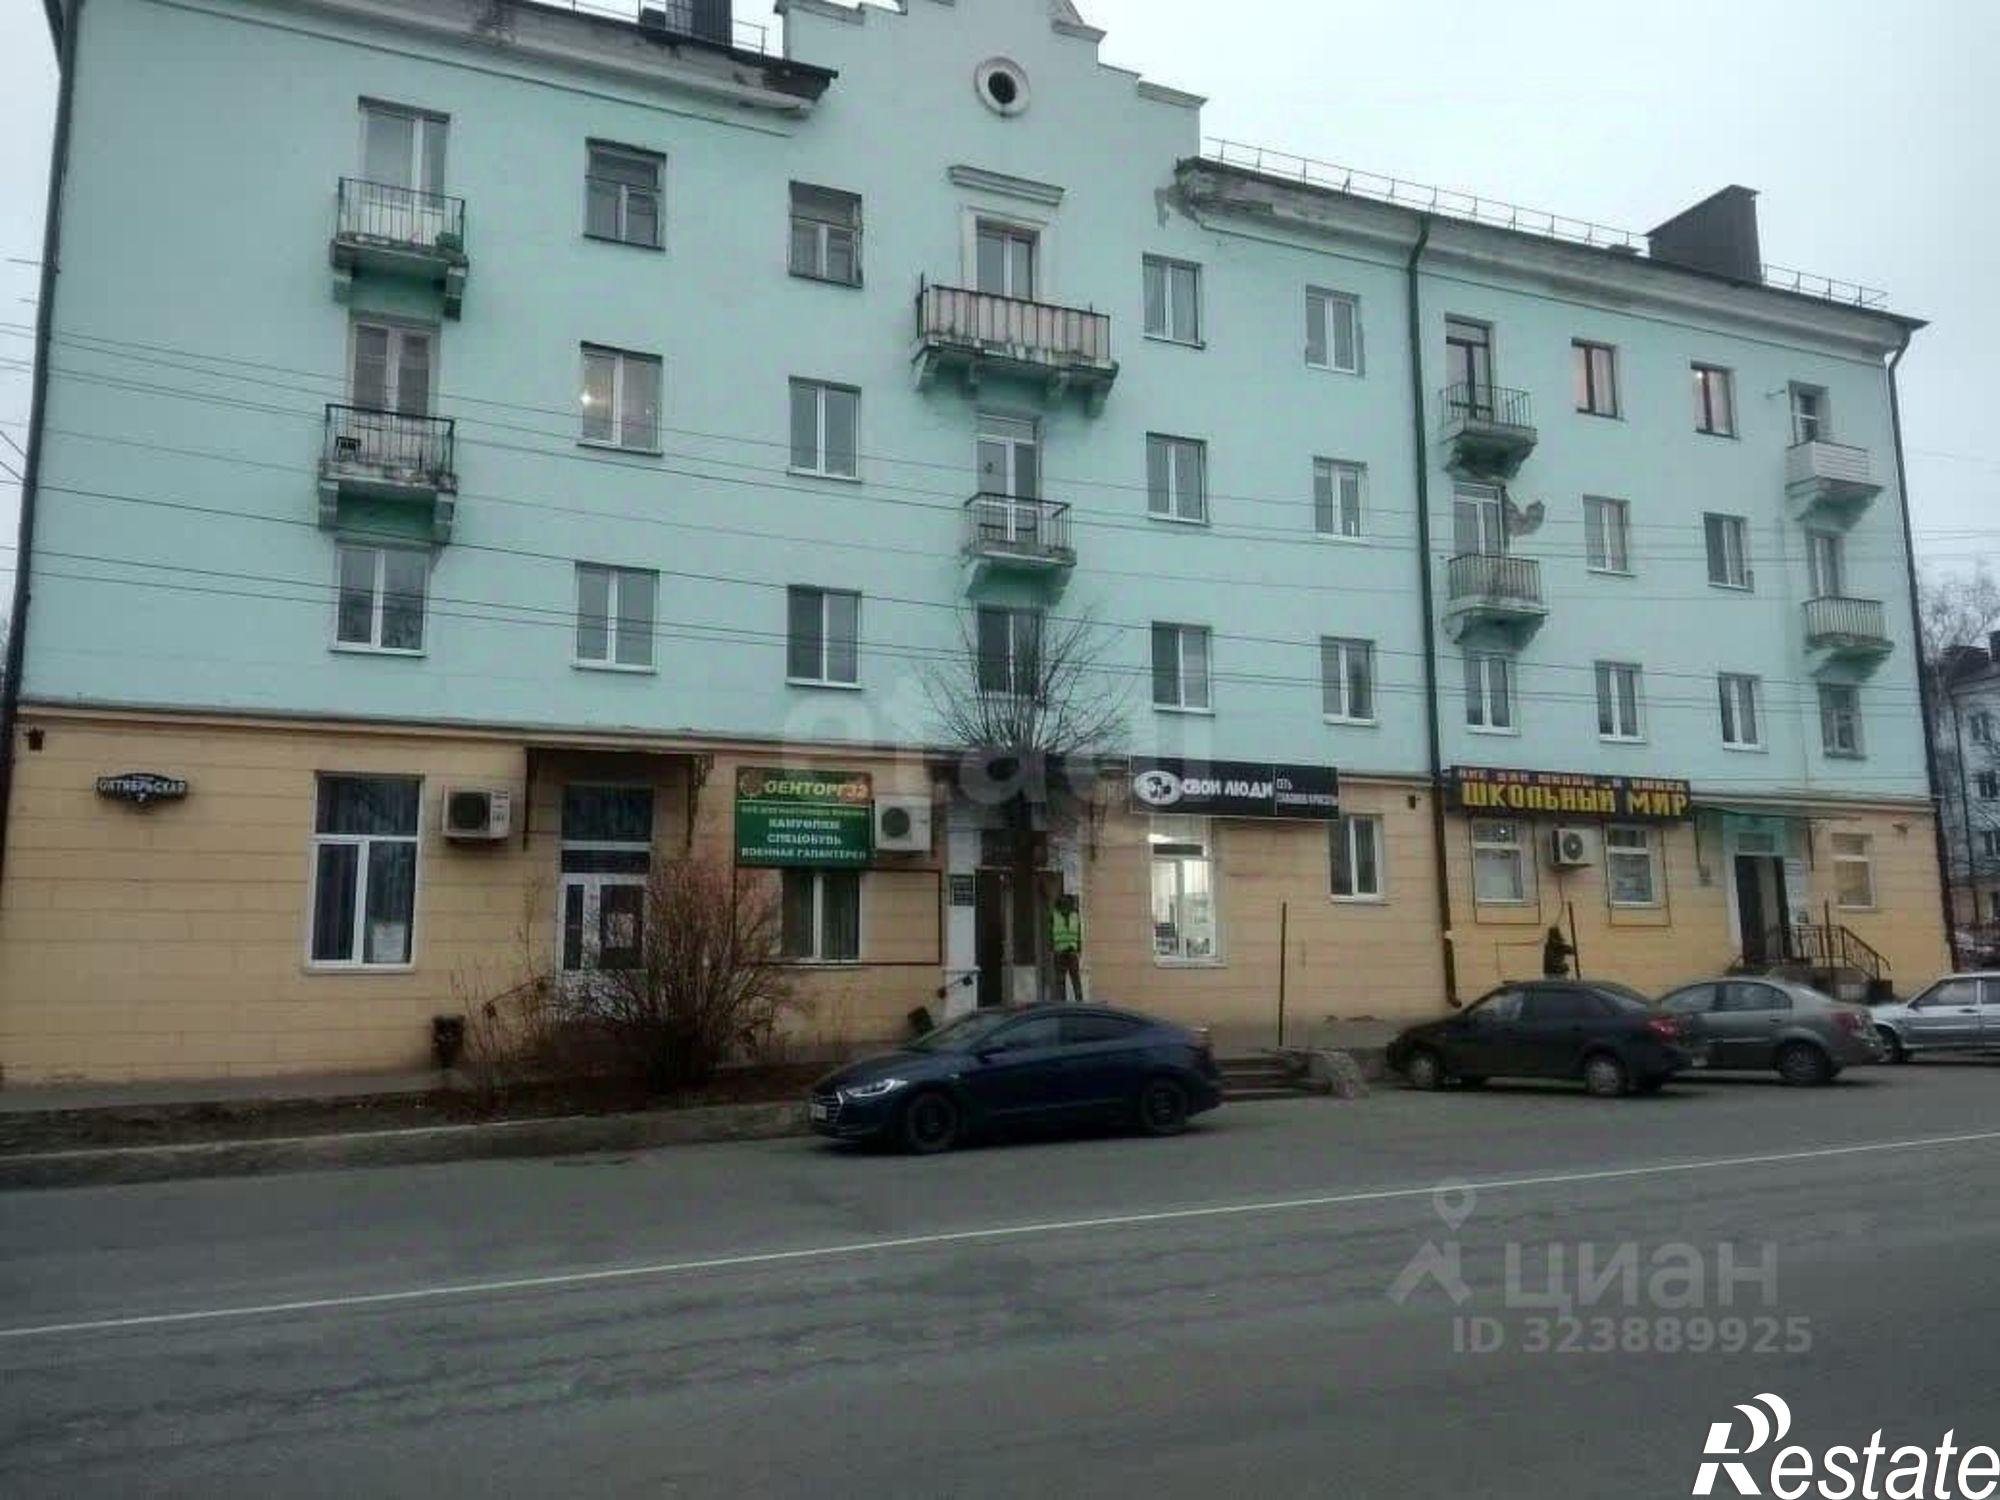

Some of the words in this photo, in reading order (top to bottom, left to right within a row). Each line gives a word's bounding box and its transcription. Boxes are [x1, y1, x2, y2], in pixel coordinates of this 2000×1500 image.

[1182, 778, 1221, 795] СВОИ
[1224, 780, 1273, 798] ЛЮДИ
[1461, 781, 1617, 813] ШКОЛЬНЫЙ
[1625, 790, 1689, 816] МИР
